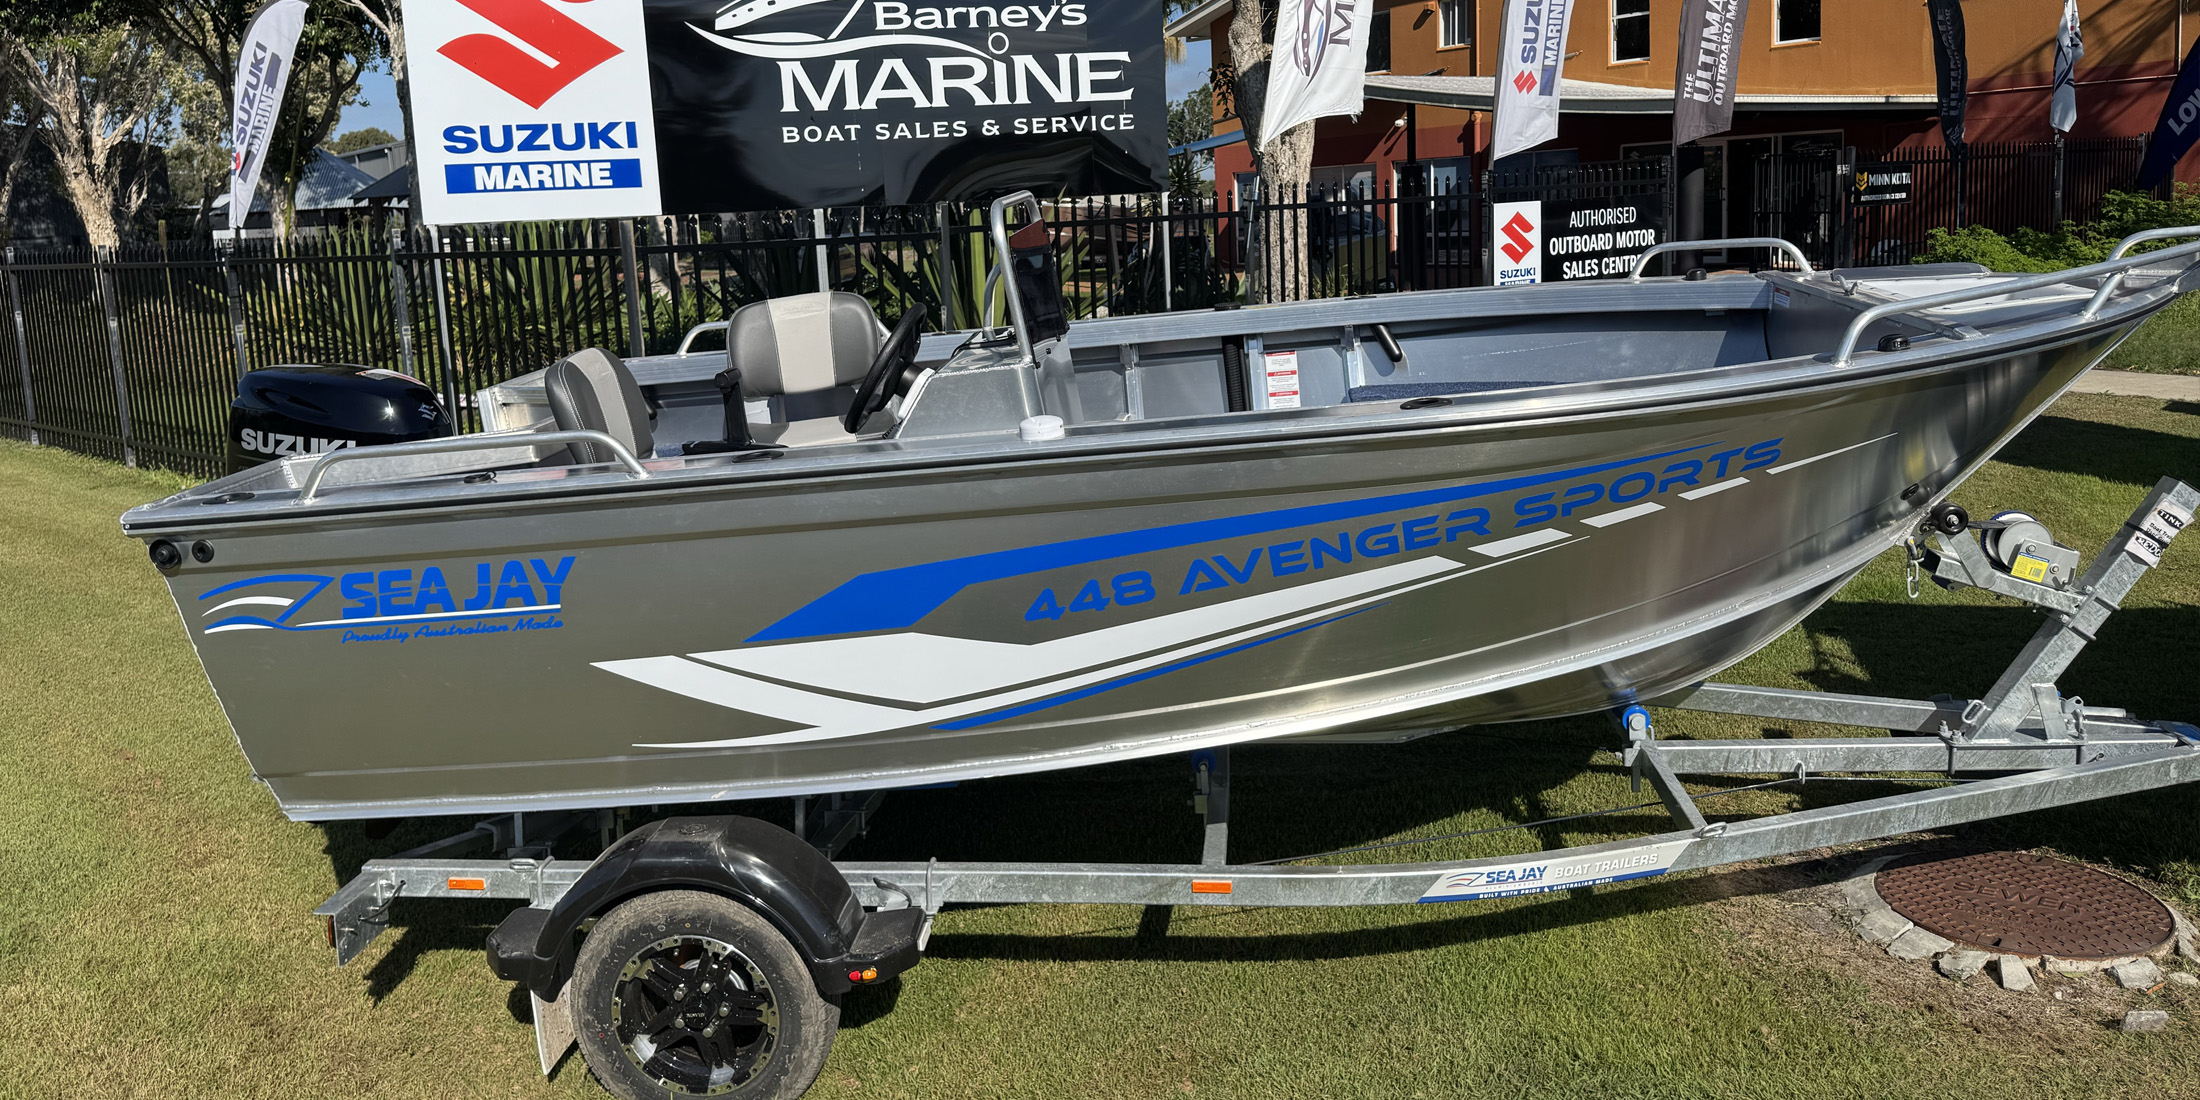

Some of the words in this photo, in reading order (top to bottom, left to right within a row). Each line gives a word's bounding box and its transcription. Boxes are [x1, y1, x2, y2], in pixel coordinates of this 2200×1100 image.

[874, 0, 1088, 32] Barney's
[1713, 22, 1734, 106] OUTBOARD
[236, 40, 268, 145] SUZUKI
[776, 51, 1136, 112] MARINE
[1683, 73, 1696, 99] THE
[250, 84, 275, 154] MARINE
[782, 124, 861, 143] BOAT
[875, 119, 968, 140] SALES
[981, 119, 1000, 136] &
[1013, 113, 1135, 135] SERVICE
[442, 121, 639, 154] SUZUKI
[474, 161, 614, 191] MARINE
[1868, 173, 1891, 186] MINN
[1891, 172, 1912, 185] KOTA
[1569, 206, 1637, 228] AUTHORISED
[1549, 234, 1613, 256] OUTBOARD
[1616, 228, 1655, 249] MOTOR
[1499, 267, 1536, 279] SUZUKI
[1562, 258, 1599, 280] SALES
[1601, 254, 1642, 275] CENTR
[1023, 570, 1157, 623] 448
[1178, 507, 1492, 596] AVENGER
[1512, 437, 1785, 528] SPORTS
[340, 566, 457, 619] SEA
[465, 556, 577, 610] JAY
[341, 629, 409, 644] Proudly
[414, 621, 510, 639] Australian
[512, 616, 564, 633] Made
[1485, 869, 1517, 884] SEA
[1518, 865, 1548, 880] JAY
[1554, 864, 1591, 879] BOAT
[1594, 853, 1659, 873] TRAILERS
[1553, 880, 1593, 890] AUSTRALIAN
[1952, 880, 2082, 914] SEWER
